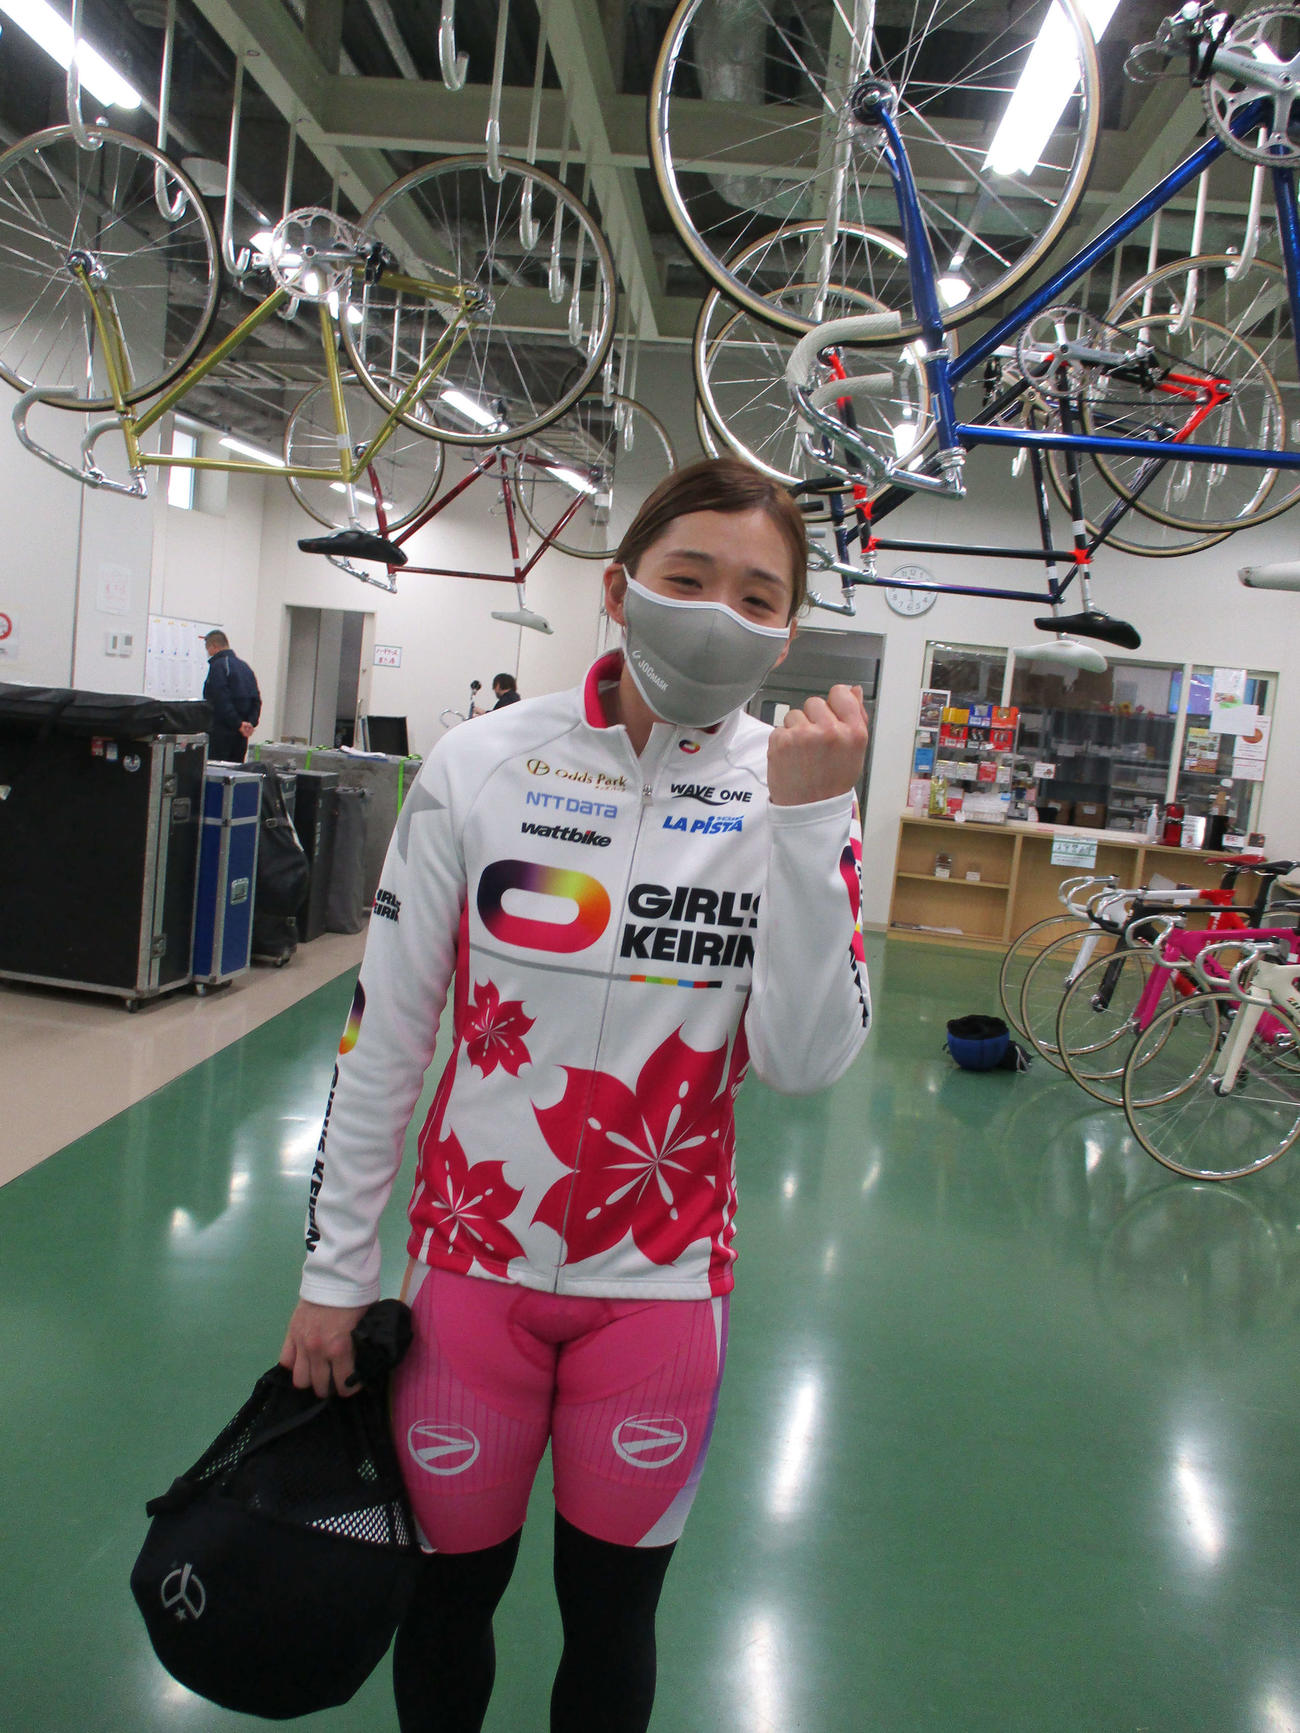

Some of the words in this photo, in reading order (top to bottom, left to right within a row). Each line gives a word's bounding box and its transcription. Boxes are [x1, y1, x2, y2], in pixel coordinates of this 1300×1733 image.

[595, 773, 628, 787] Park
[670, 784, 716, 799] WAVE
[720, 789, 753, 803] ONE
[662, 815, 689, 832] LA
[521, 822, 612, 847] wattbike
